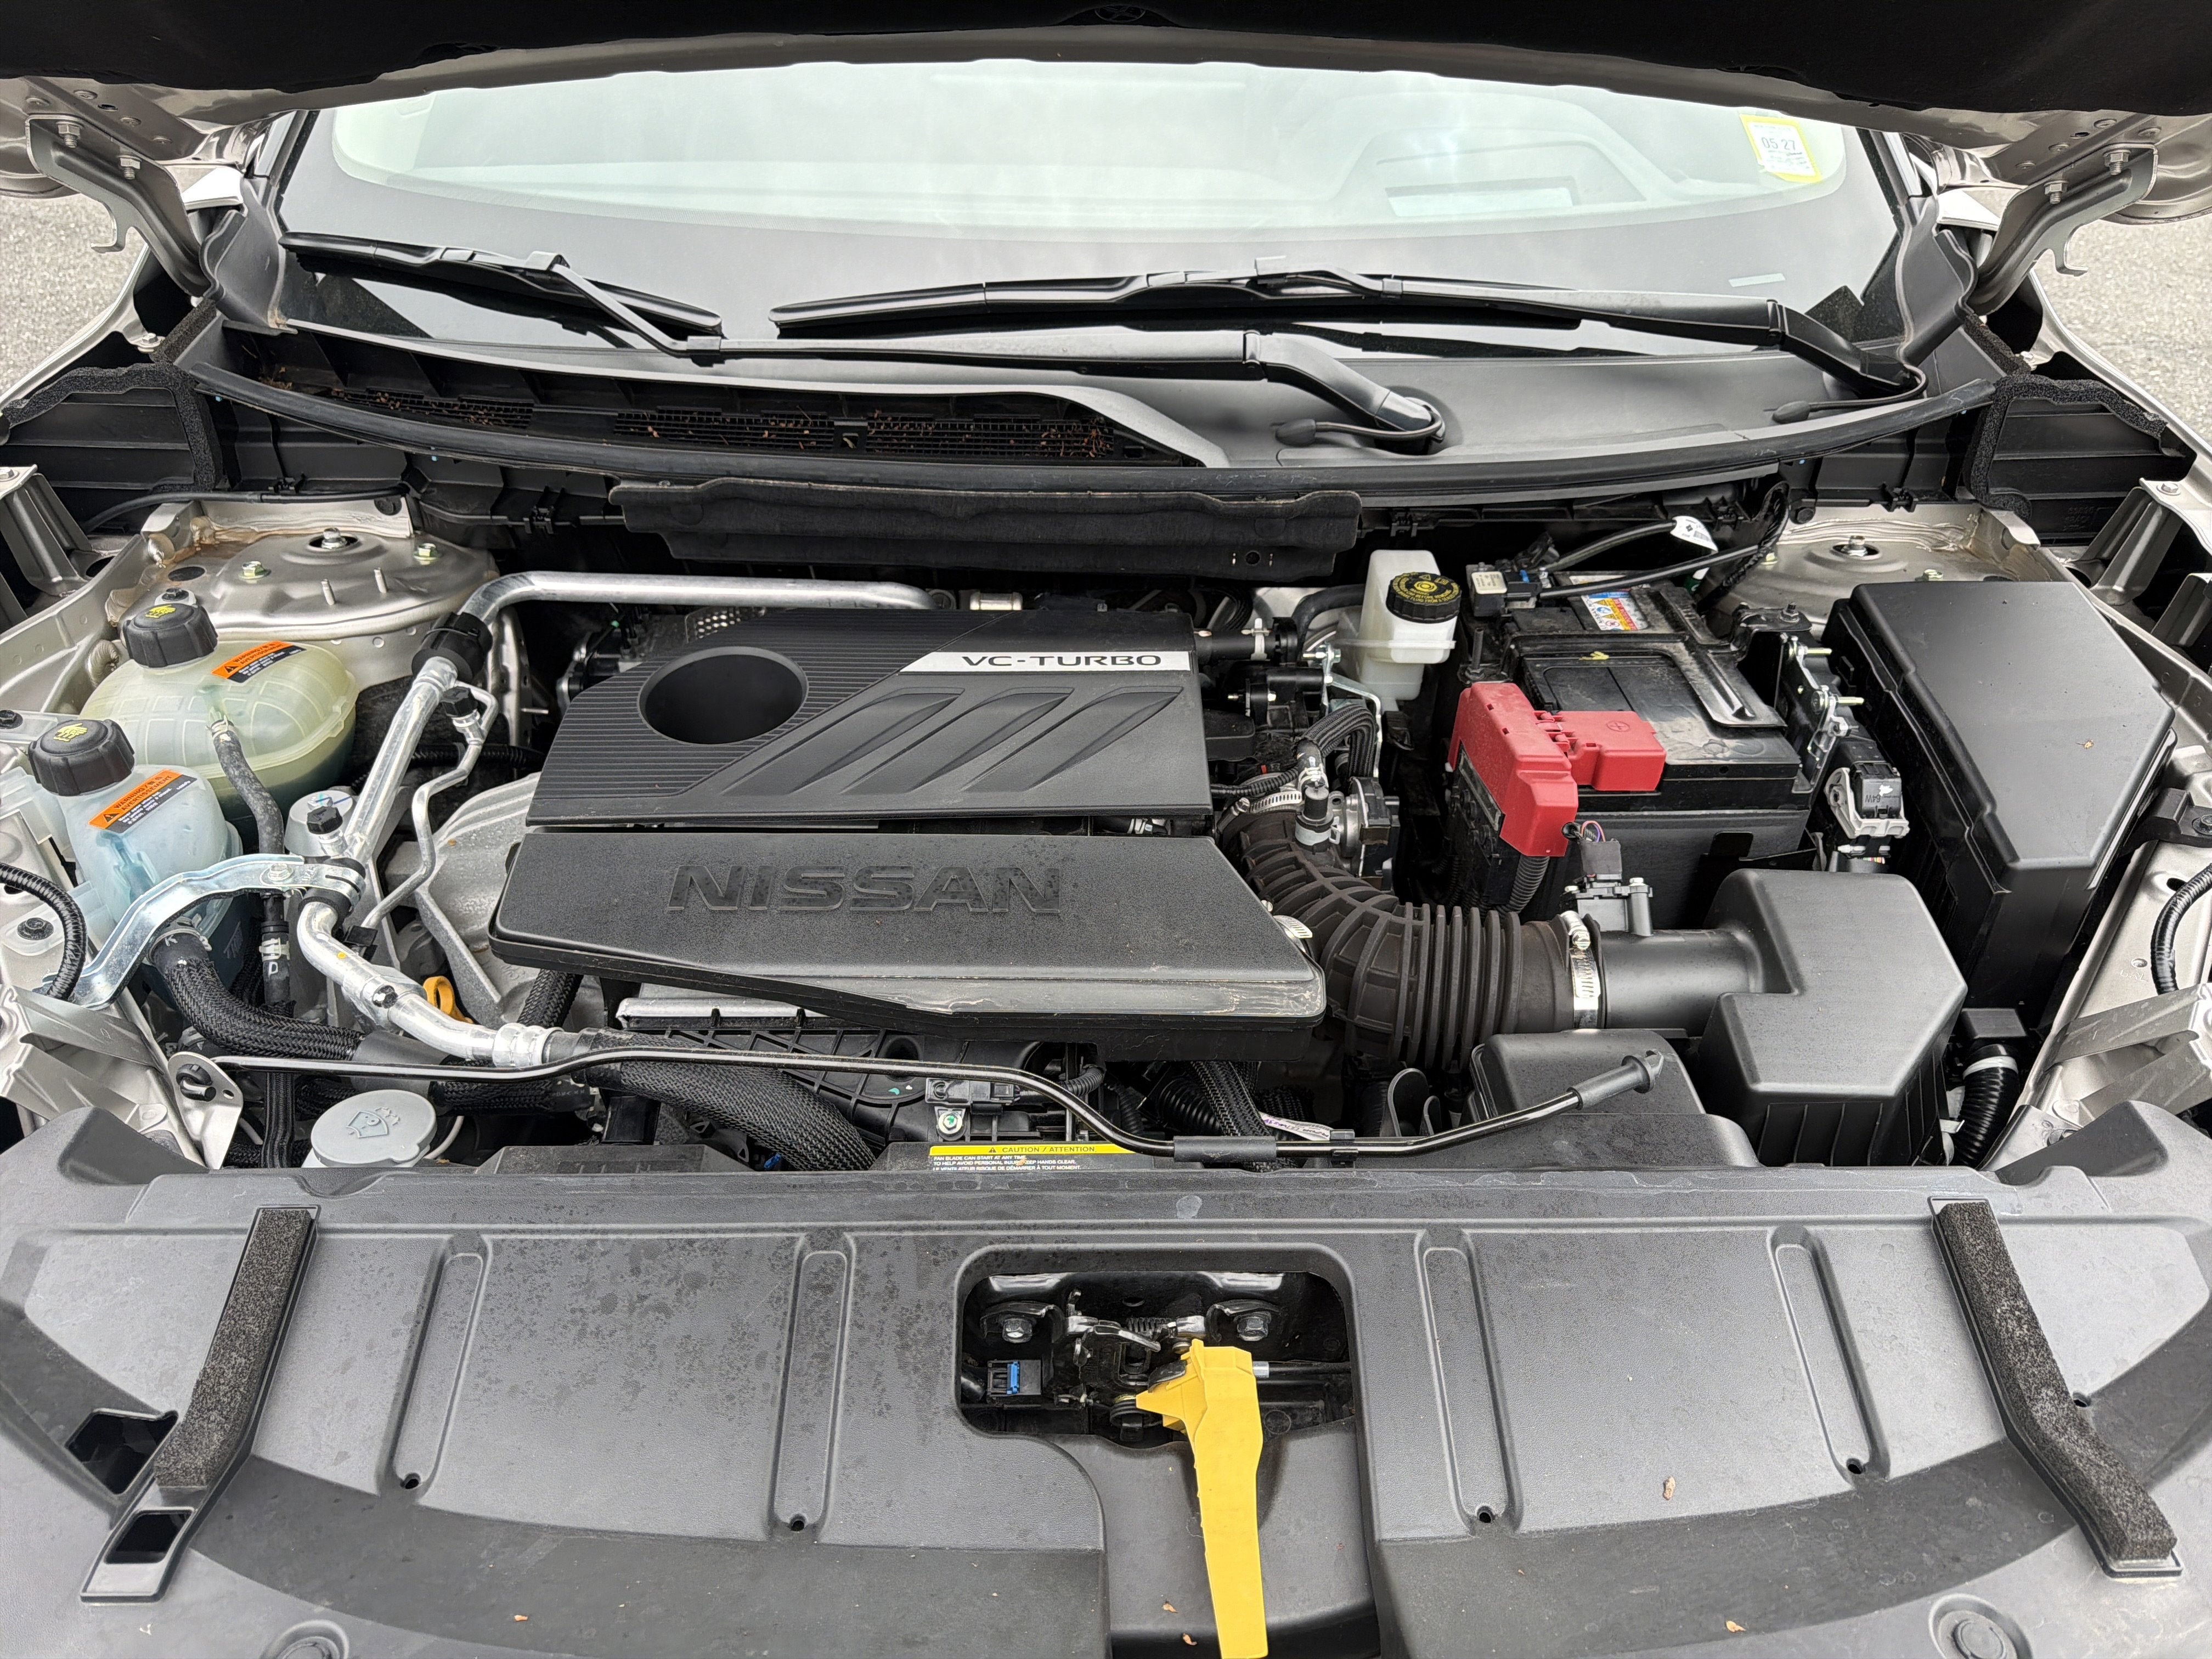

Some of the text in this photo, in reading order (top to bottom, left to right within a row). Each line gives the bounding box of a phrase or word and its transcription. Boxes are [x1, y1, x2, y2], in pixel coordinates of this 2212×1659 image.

[1761, 137, 1796, 150] 05 27
[962, 655, 1161, 666] VC-TURBO
[114, 787, 145, 809] WARNING
[121, 776, 172, 810] AVERTISSEMENT
[1865, 794, 1881, 803] 64W
[668, 865, 1061, 913] NISSAN
